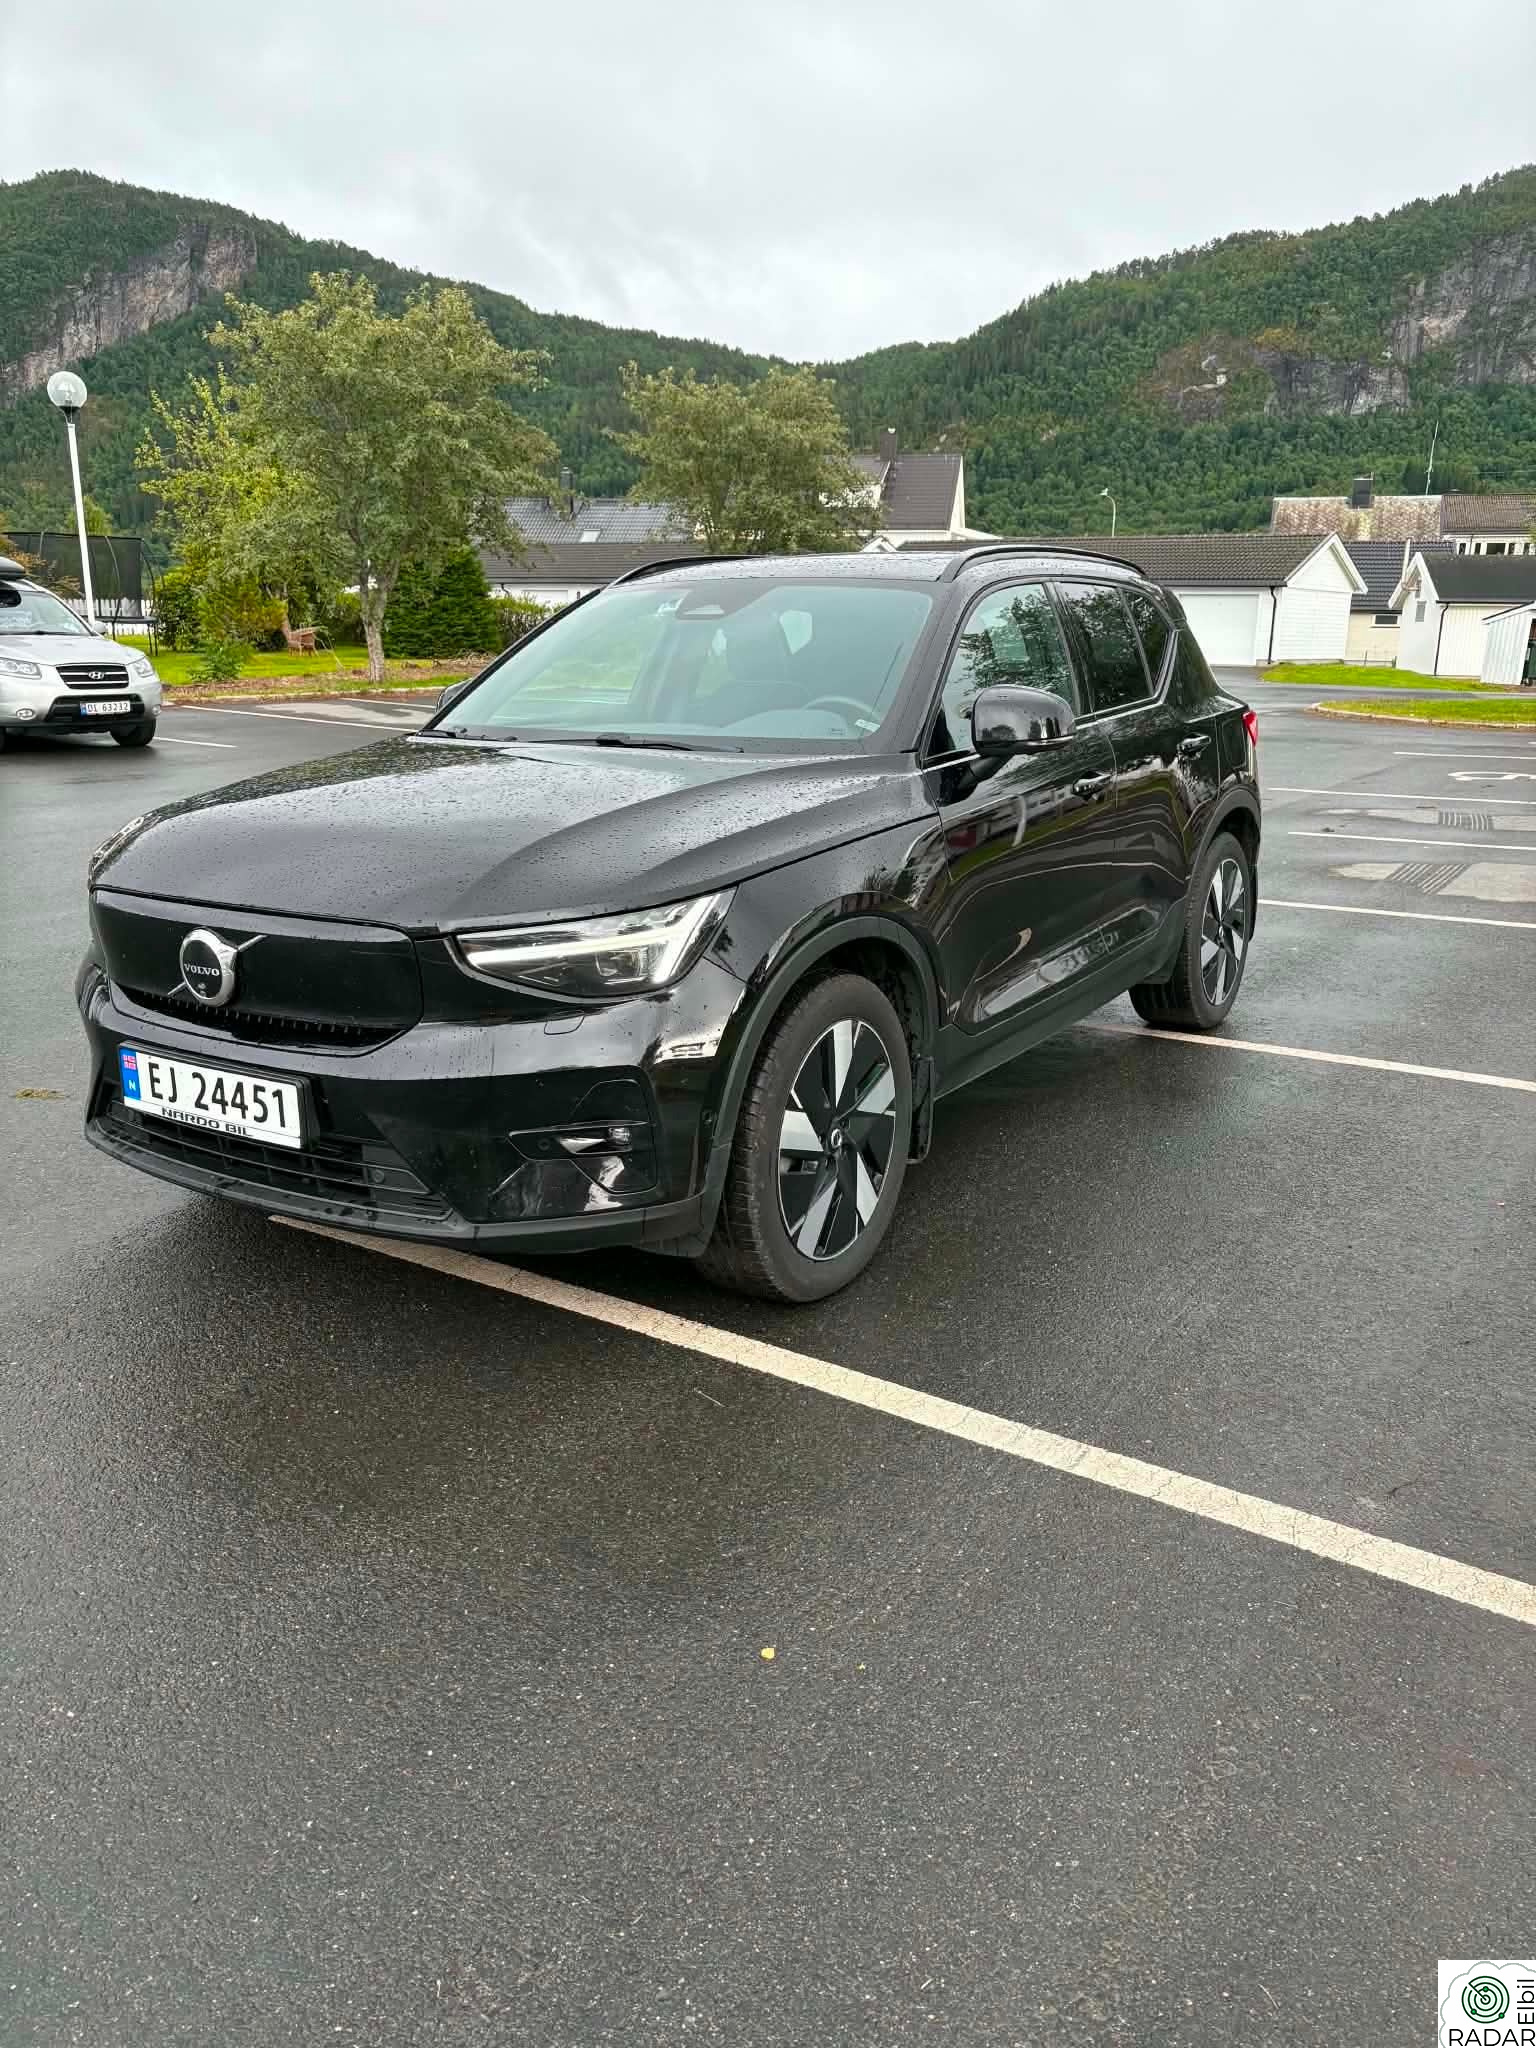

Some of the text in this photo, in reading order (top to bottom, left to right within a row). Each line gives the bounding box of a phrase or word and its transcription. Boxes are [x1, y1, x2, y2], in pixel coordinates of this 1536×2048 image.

[183, 963, 220, 976] VOLVO
[128, 1079, 136, 1091] N
[148, 1062, 286, 1128] EJ 24451
[161, 1107, 254, 1136] NARDO BIL
